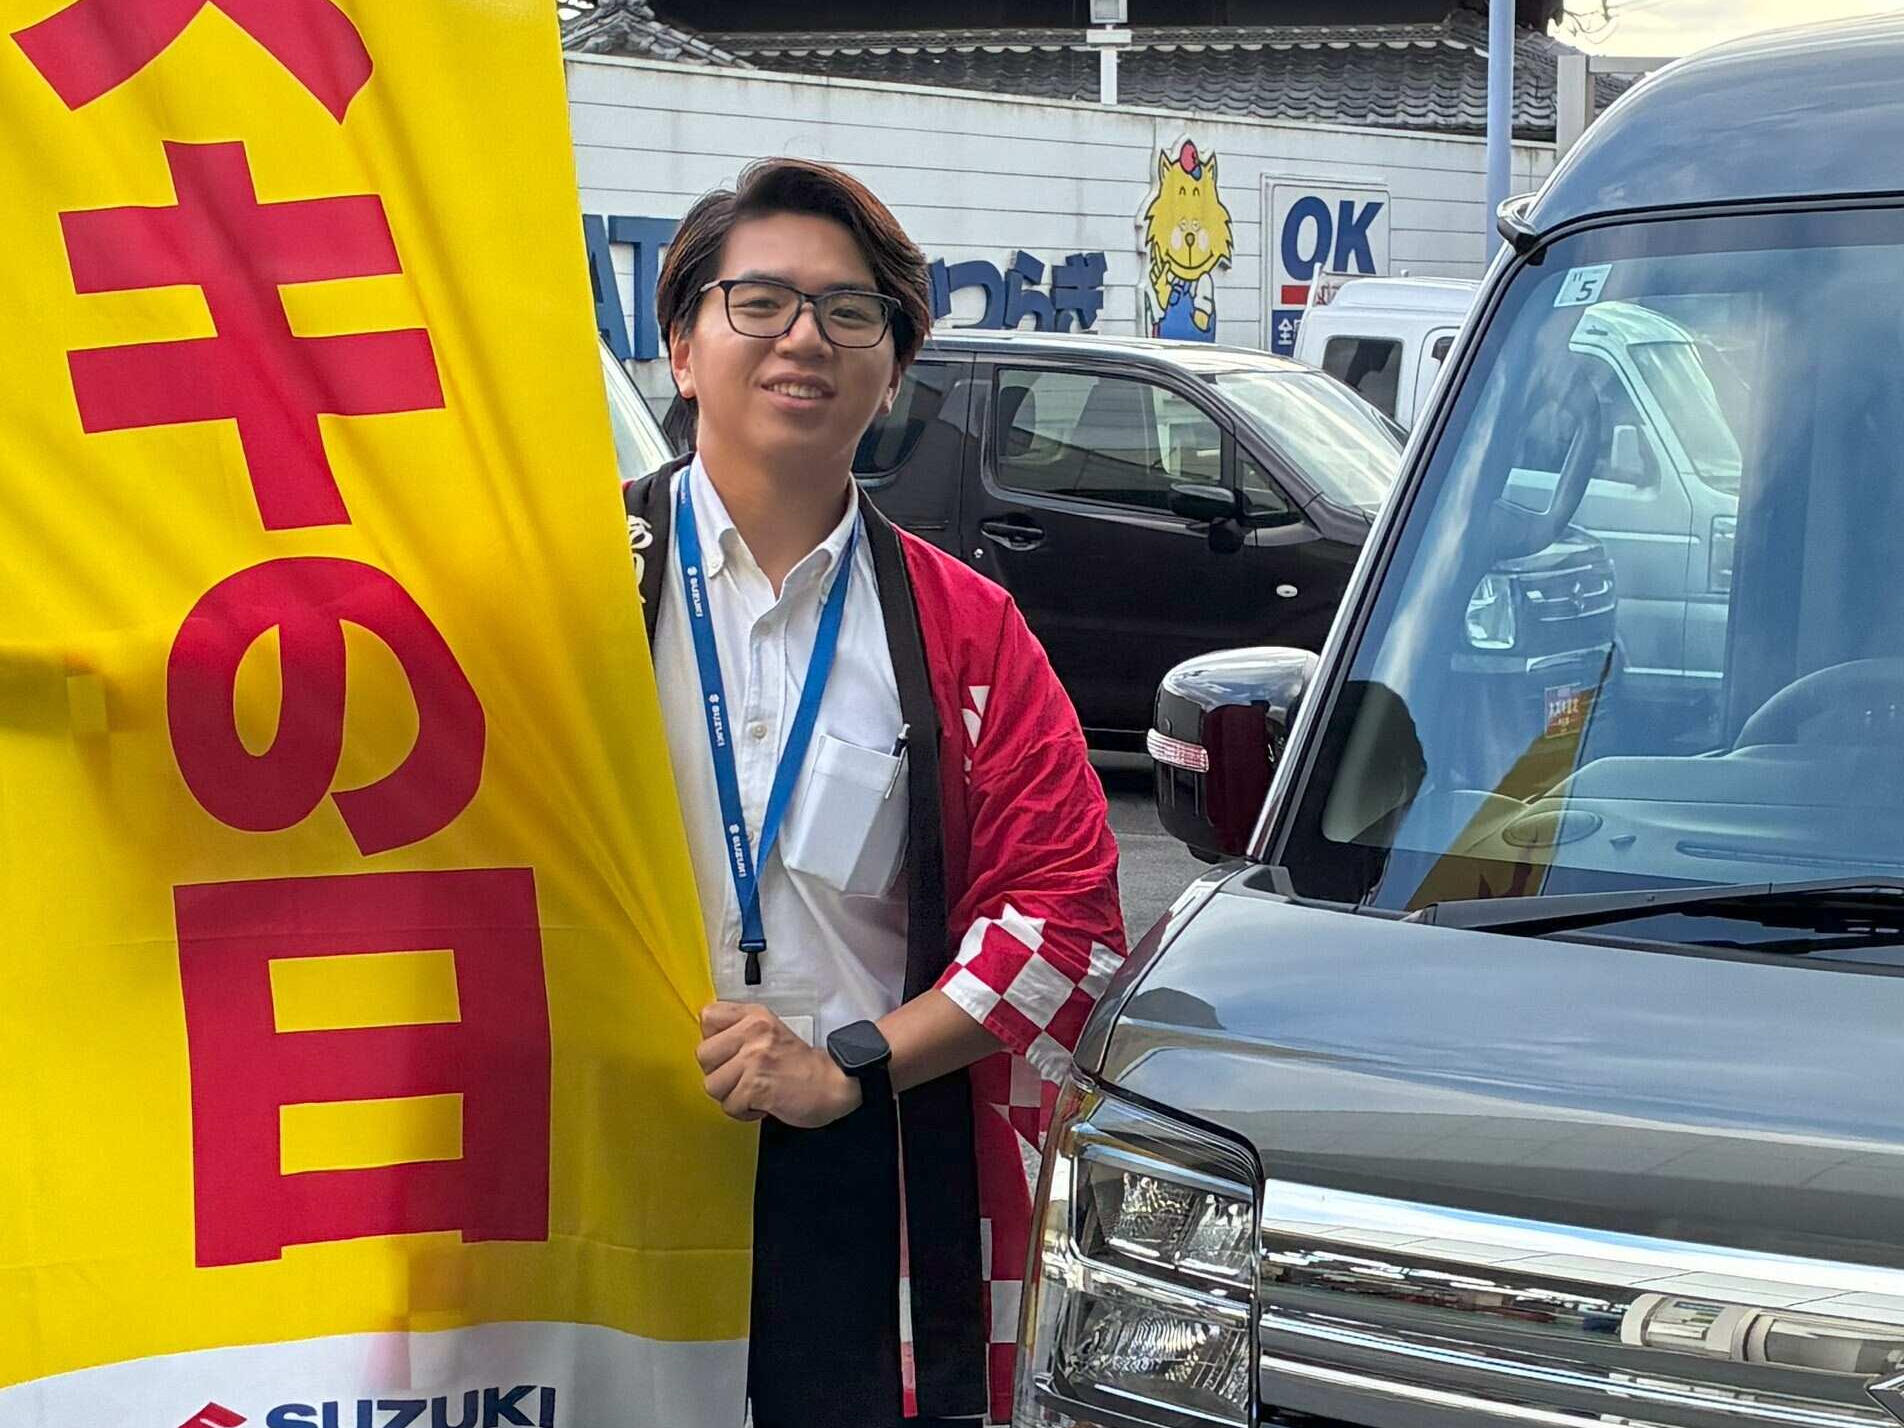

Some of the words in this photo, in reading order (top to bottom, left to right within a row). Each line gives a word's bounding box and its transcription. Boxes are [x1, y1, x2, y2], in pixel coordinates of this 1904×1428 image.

[1281, 196, 1385, 281] OK
[928, 250, 1108, 332] つらぎ
[1576, 279, 1598, 302] 5
